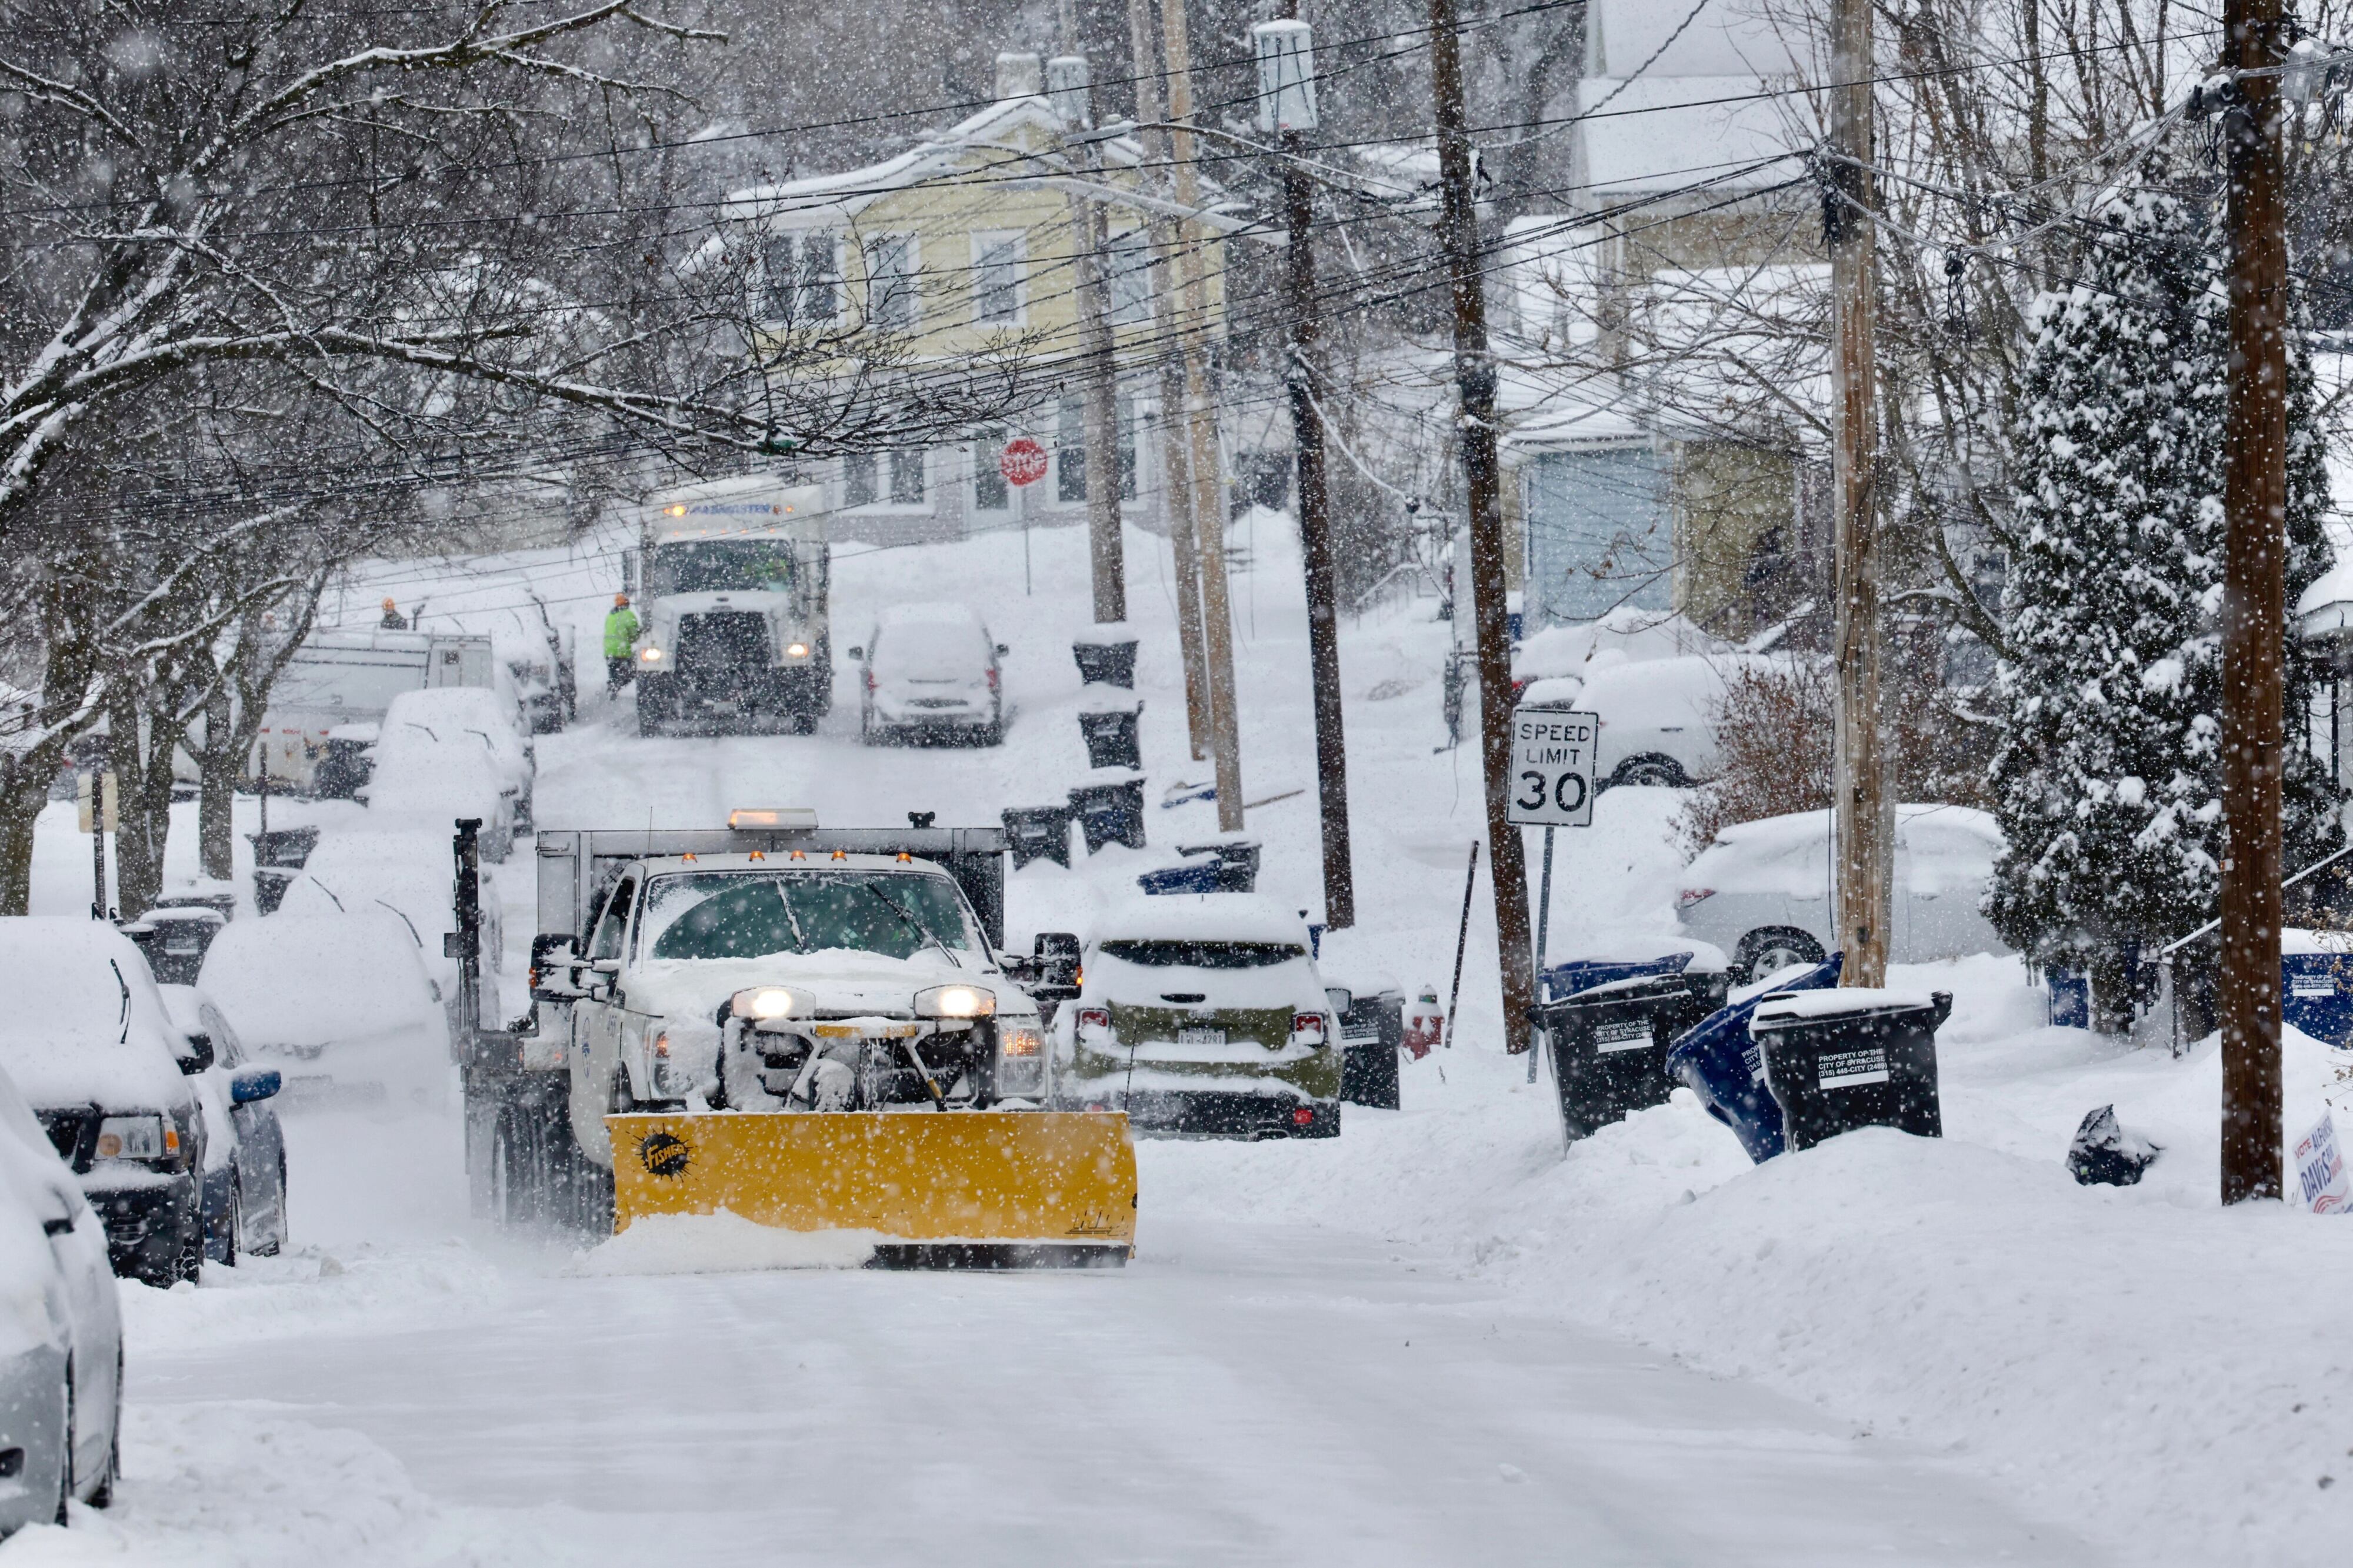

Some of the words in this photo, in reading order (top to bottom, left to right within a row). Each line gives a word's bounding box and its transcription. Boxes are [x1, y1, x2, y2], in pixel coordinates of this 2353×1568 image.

[1002, 453, 1046, 473] STOP
[1520, 723, 1591, 742] SPEED
[1526, 748, 1581, 765] LIMIT
[1517, 770, 1587, 813] 30
[1189, 1009, 1214, 1020] Jeep
[1597, 1023, 1627, 1031] PROPERTY
[1619, 1025, 1651, 1034] SYRACUSE
[1611, 1033, 1635, 1041] 448-CITY
[1745, 1052, 1759, 1065] CITY
[1818, 1052, 1857, 1063] PROPERTY
[1818, 1062, 1834, 1070] CITY
[1847, 1055, 1886, 1066] SYRACUSE
[1818, 1070, 1835, 1078] (315)
[1836, 1065, 1866, 1075] 448-CITY
[1867, 1062, 1888, 1072] (2489)
[2295, 1138, 2312, 1159] VOTE
[2312, 1115, 2334, 1153] ALFONSO
[646, 1143, 686, 1170] FISHER
[2325, 1143, 2335, 1163] FOR
